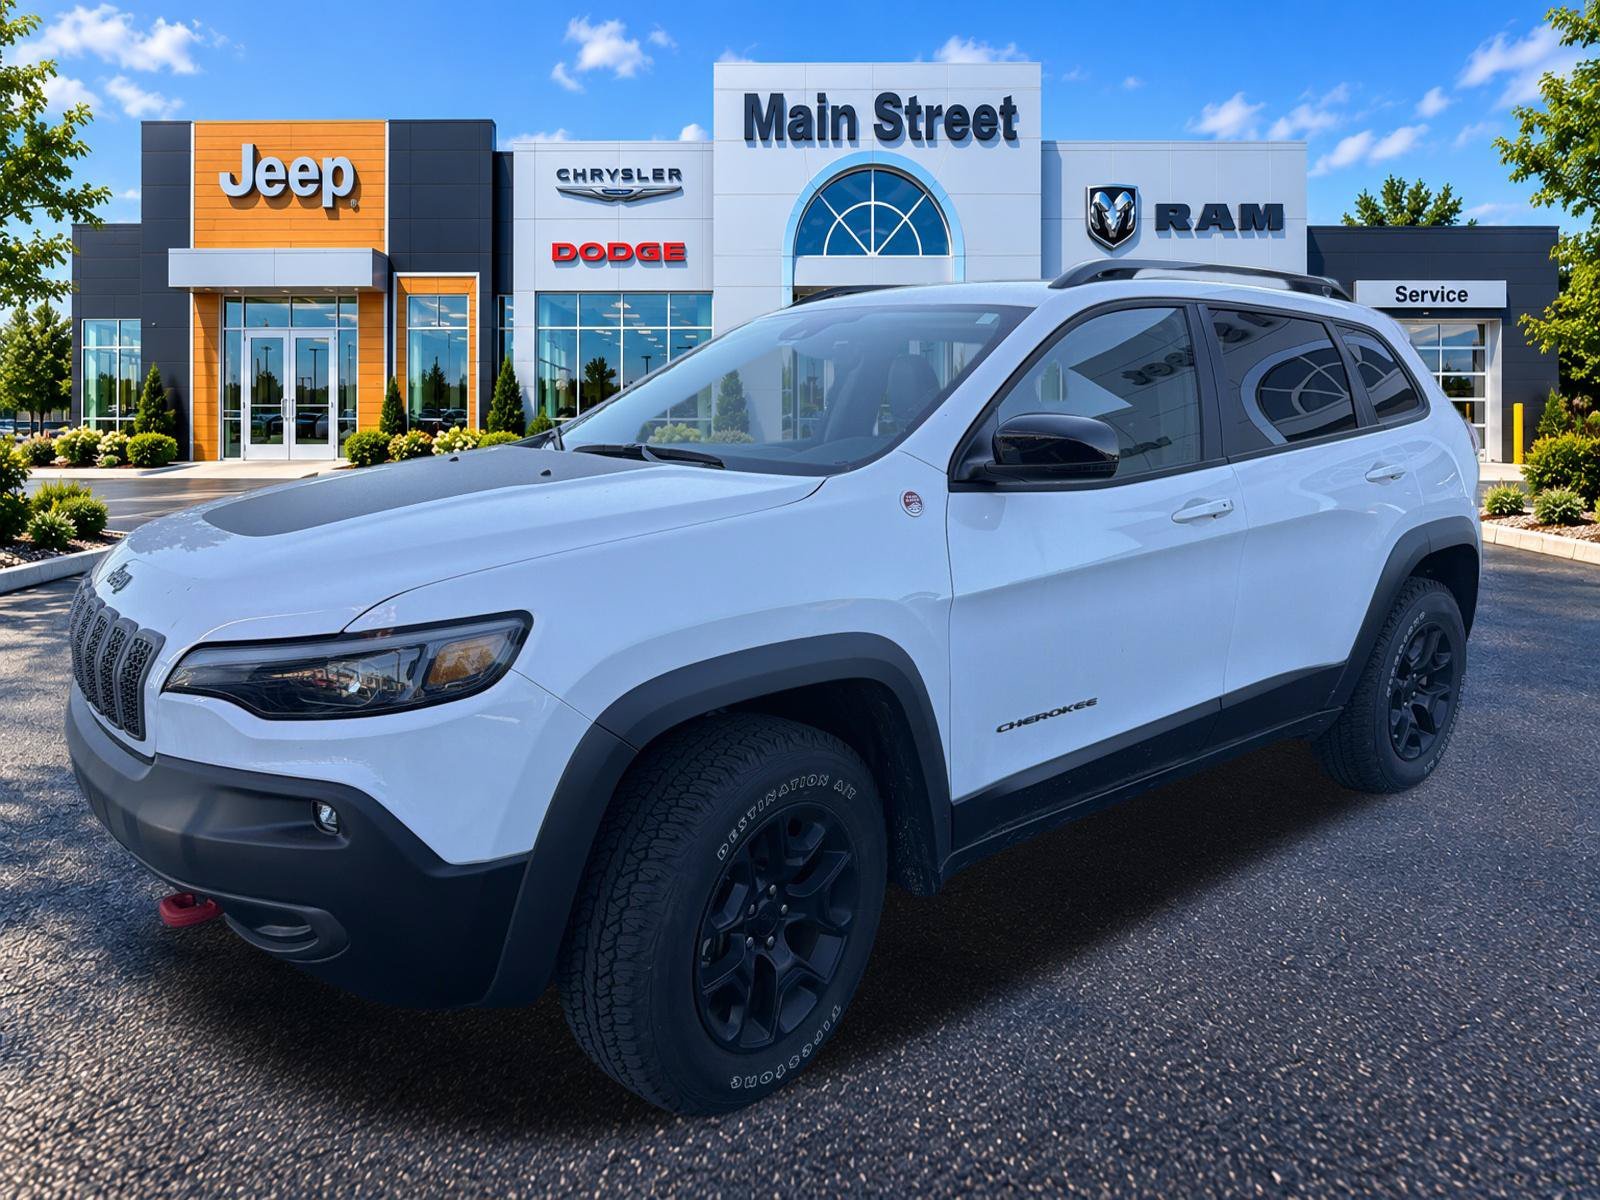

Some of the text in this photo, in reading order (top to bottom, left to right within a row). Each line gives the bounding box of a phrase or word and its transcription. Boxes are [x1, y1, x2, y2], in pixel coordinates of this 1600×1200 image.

[744, 91, 1017, 141] Main Street
[218, 143, 354, 208] Jeep
[556, 168, 682, 182] CHRYSLER
[1155, 203, 1284, 231] RAM
[551, 242, 686, 261] DODGE
[1395, 285, 1469, 303] Service
[996, 697, 1098, 733] CHEROKEE
[716, 773, 830, 861] DESTINATION
